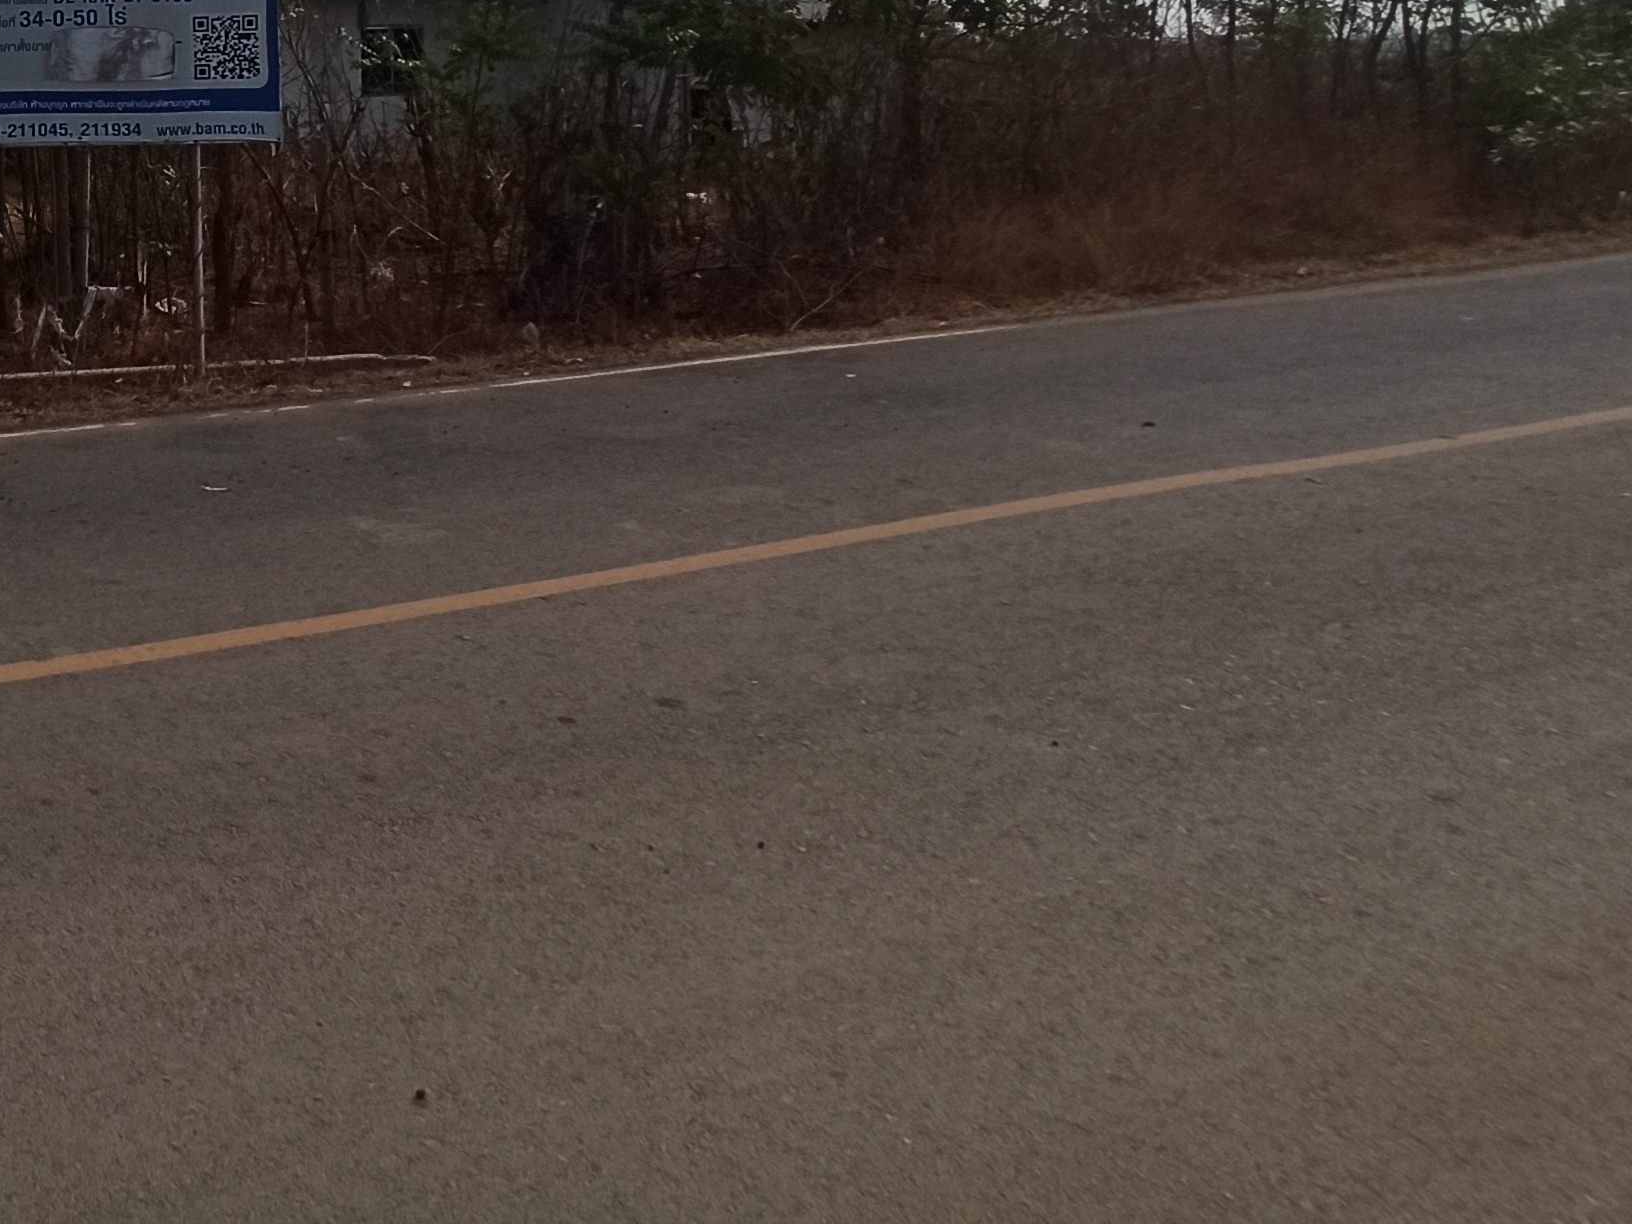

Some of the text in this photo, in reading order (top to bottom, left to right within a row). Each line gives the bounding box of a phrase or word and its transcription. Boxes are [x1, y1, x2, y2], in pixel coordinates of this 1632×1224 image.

[19, 9, 98, 27] 34-0-50
[106, 3, 127, 25] ไร่
[80, 122, 142, 137] 211934
[156, 122, 265, 137] www.bam.co.th
